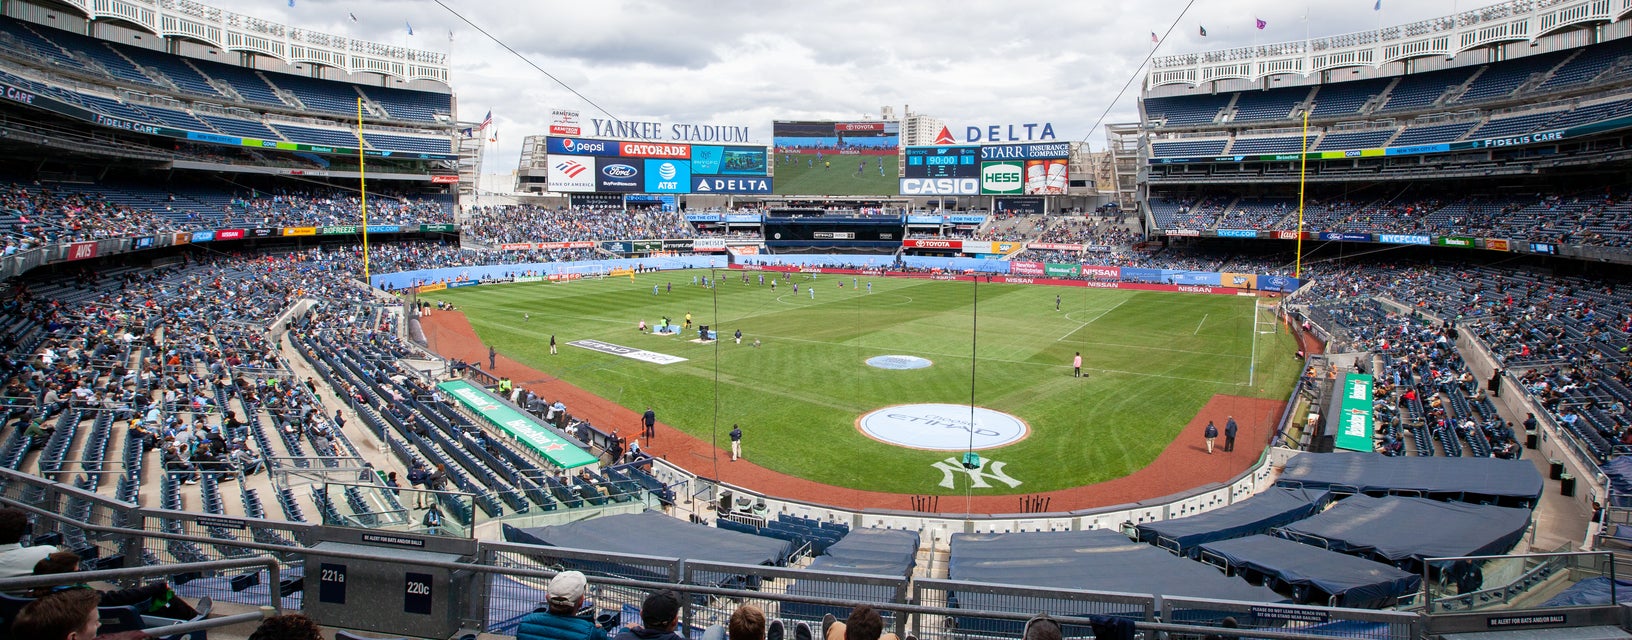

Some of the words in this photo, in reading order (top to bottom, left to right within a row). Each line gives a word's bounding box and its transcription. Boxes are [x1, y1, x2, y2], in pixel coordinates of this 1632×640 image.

[7, 87, 33, 104] CARE
[552, 110, 579, 118] ARMITRON
[98, 114, 131, 131] FIDELIS
[133, 122, 159, 134] CARE
[591, 118, 662, 140] YANKEE
[672, 123, 749, 143] STADIUM
[966, 122, 1056, 142] DELTA
[1484, 136, 1530, 148] FIDELIS
[1533, 131, 1563, 142] CARE
[577, 142, 605, 153] pepsi
[624, 144, 686, 156] GATORADE
[981, 146, 1025, 159] STARR
[930, 156, 955, 164] 90:00
[609, 166, 631, 176] Ford
[985, 173, 1020, 183] HESS
[658, 182, 678, 190] AT&T
[715, 180, 768, 191] DELTA
[902, 178, 978, 195] CASIO
[323, 227, 356, 235] BIOFREEZE
[1218, 230, 1256, 238] NYCFC.COM
[1382, 234, 1429, 243] NYCFC.COM
[75, 242, 92, 259] AVIS
[1082, 268, 1118, 277] NISSAN
[887, 413, 1000, 437] ETIHAD
[506, 419, 551, 444] Heineken
[322, 569, 345, 583] 221a
[407, 581, 430, 595] 220c
